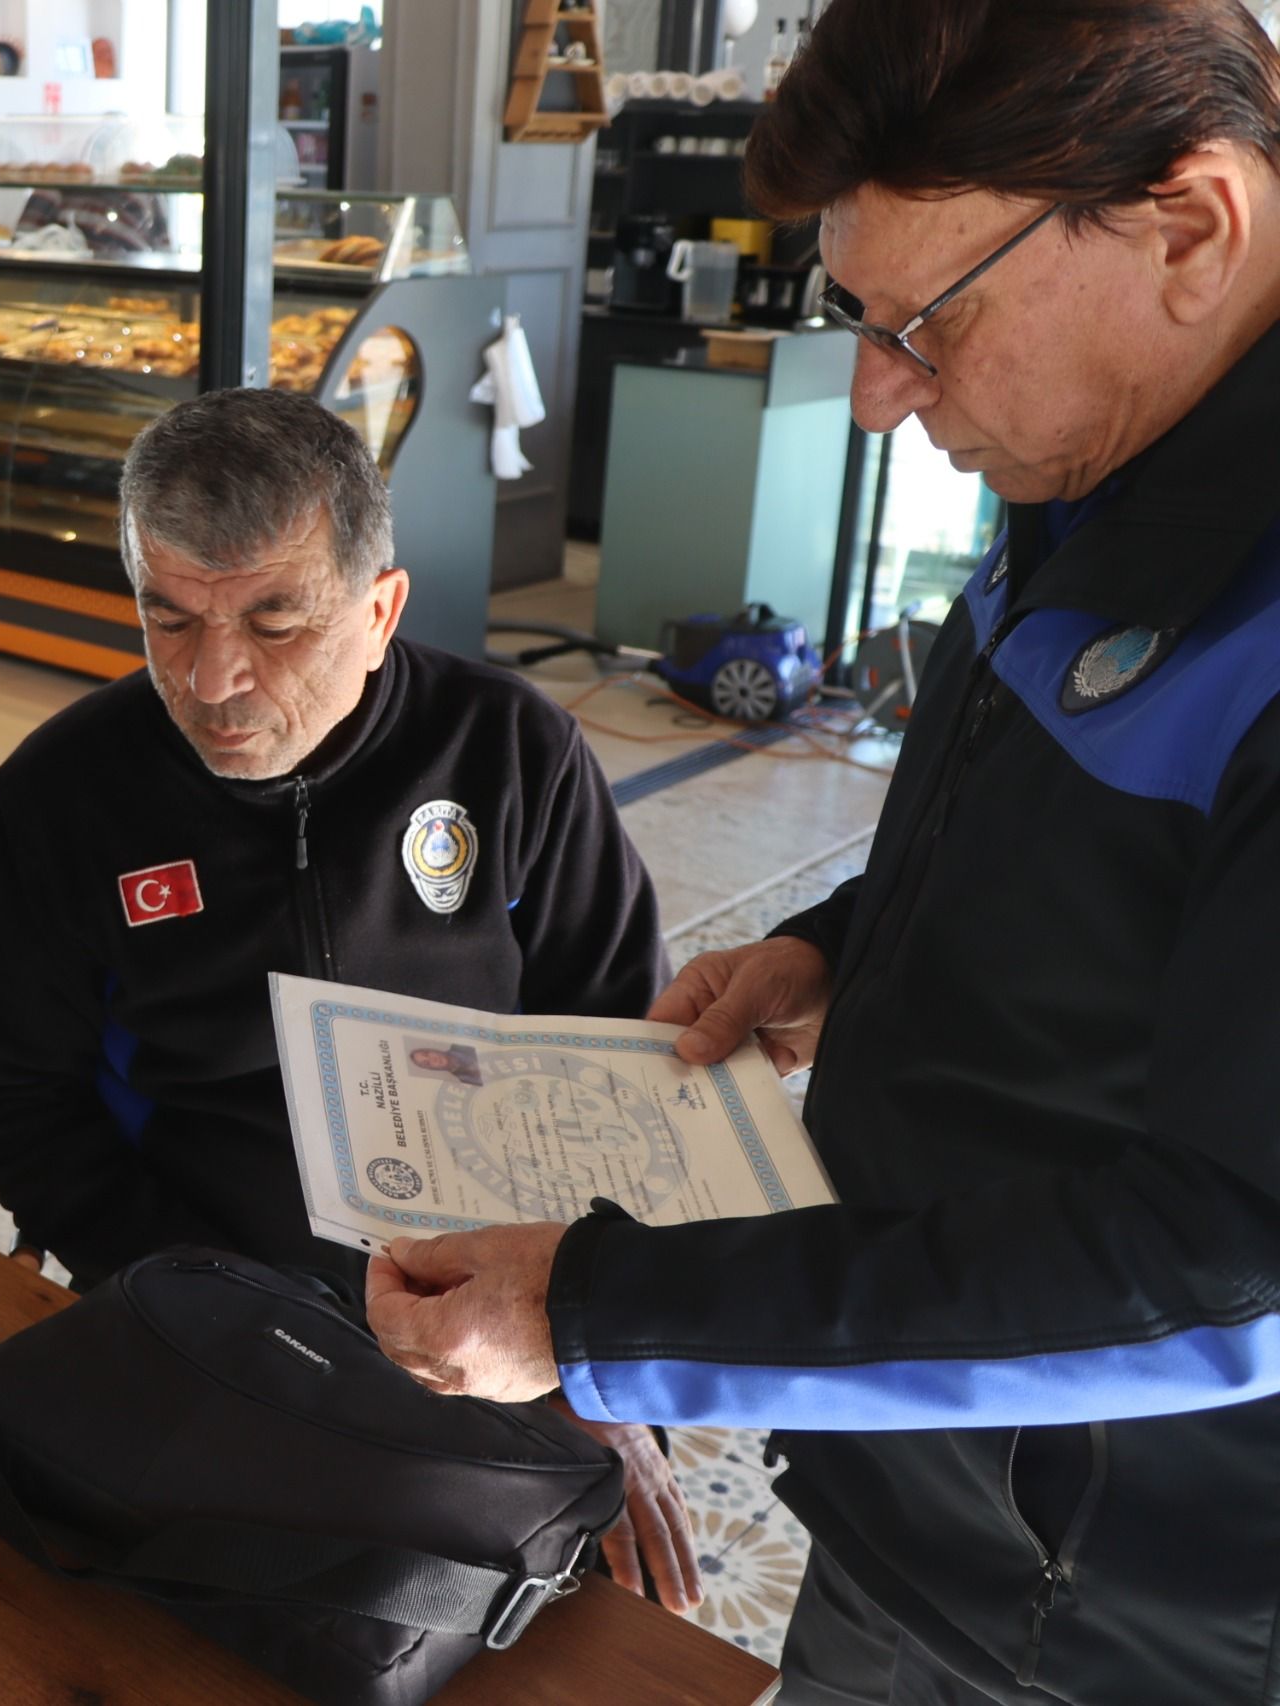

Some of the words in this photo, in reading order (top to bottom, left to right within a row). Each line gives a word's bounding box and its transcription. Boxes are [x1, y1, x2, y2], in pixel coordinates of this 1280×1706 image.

[360, 1080, 369, 1097] T.C.
[369, 1071, 386, 1109] NAZİLLİ
[377, 1039, 399, 1098] BAŞKANLIĞI
[387, 1098, 407, 1148] BELEDİYE
